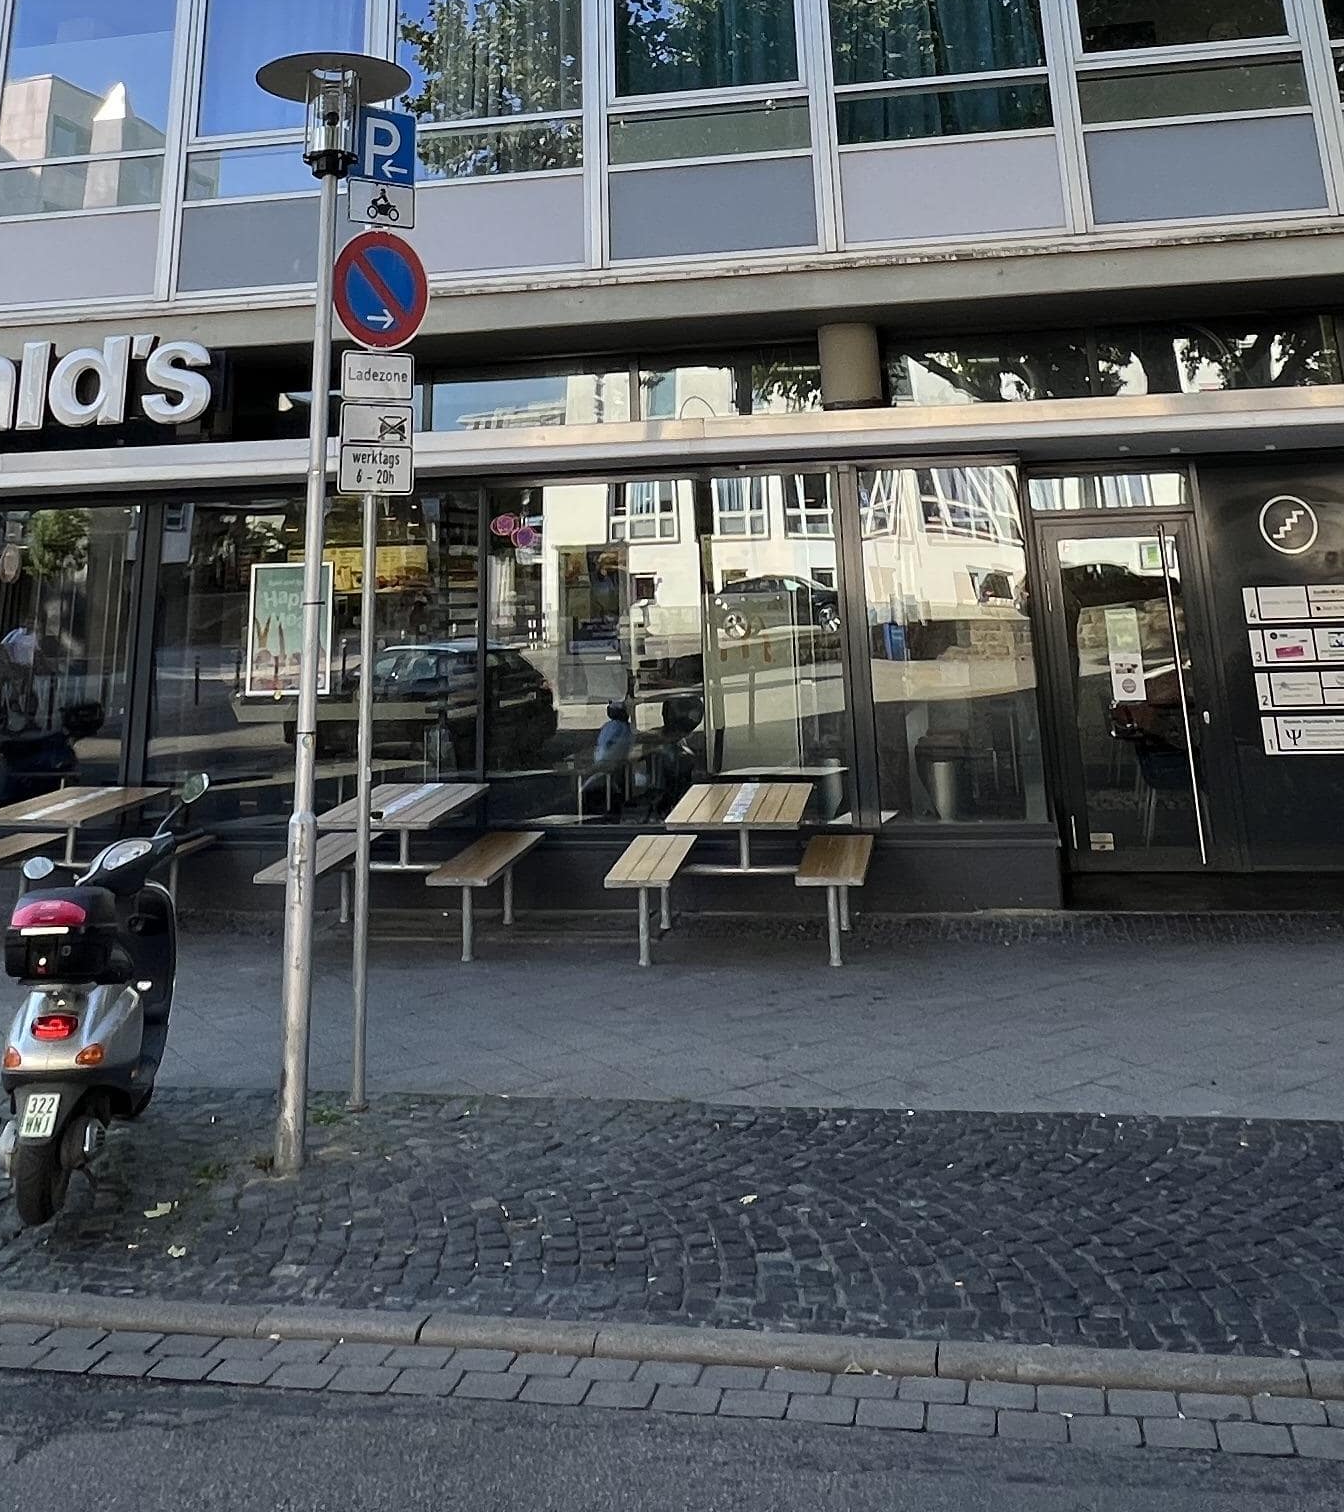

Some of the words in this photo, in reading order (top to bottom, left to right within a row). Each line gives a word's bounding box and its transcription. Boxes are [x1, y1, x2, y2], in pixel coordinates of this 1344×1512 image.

[364, 116, 401, 176] P
[347, 367, 408, 383] Ladezone
[352, 449, 400, 469] werktags
[356, 469, 362, 484] 6
[376, 469, 395, 485] 20h
[1249, 608, 1257, 619] 4
[1255, 651, 1263, 662] 3
[1261, 695, 1269, 706] 2
[28, 1097, 55, 1114] 322
